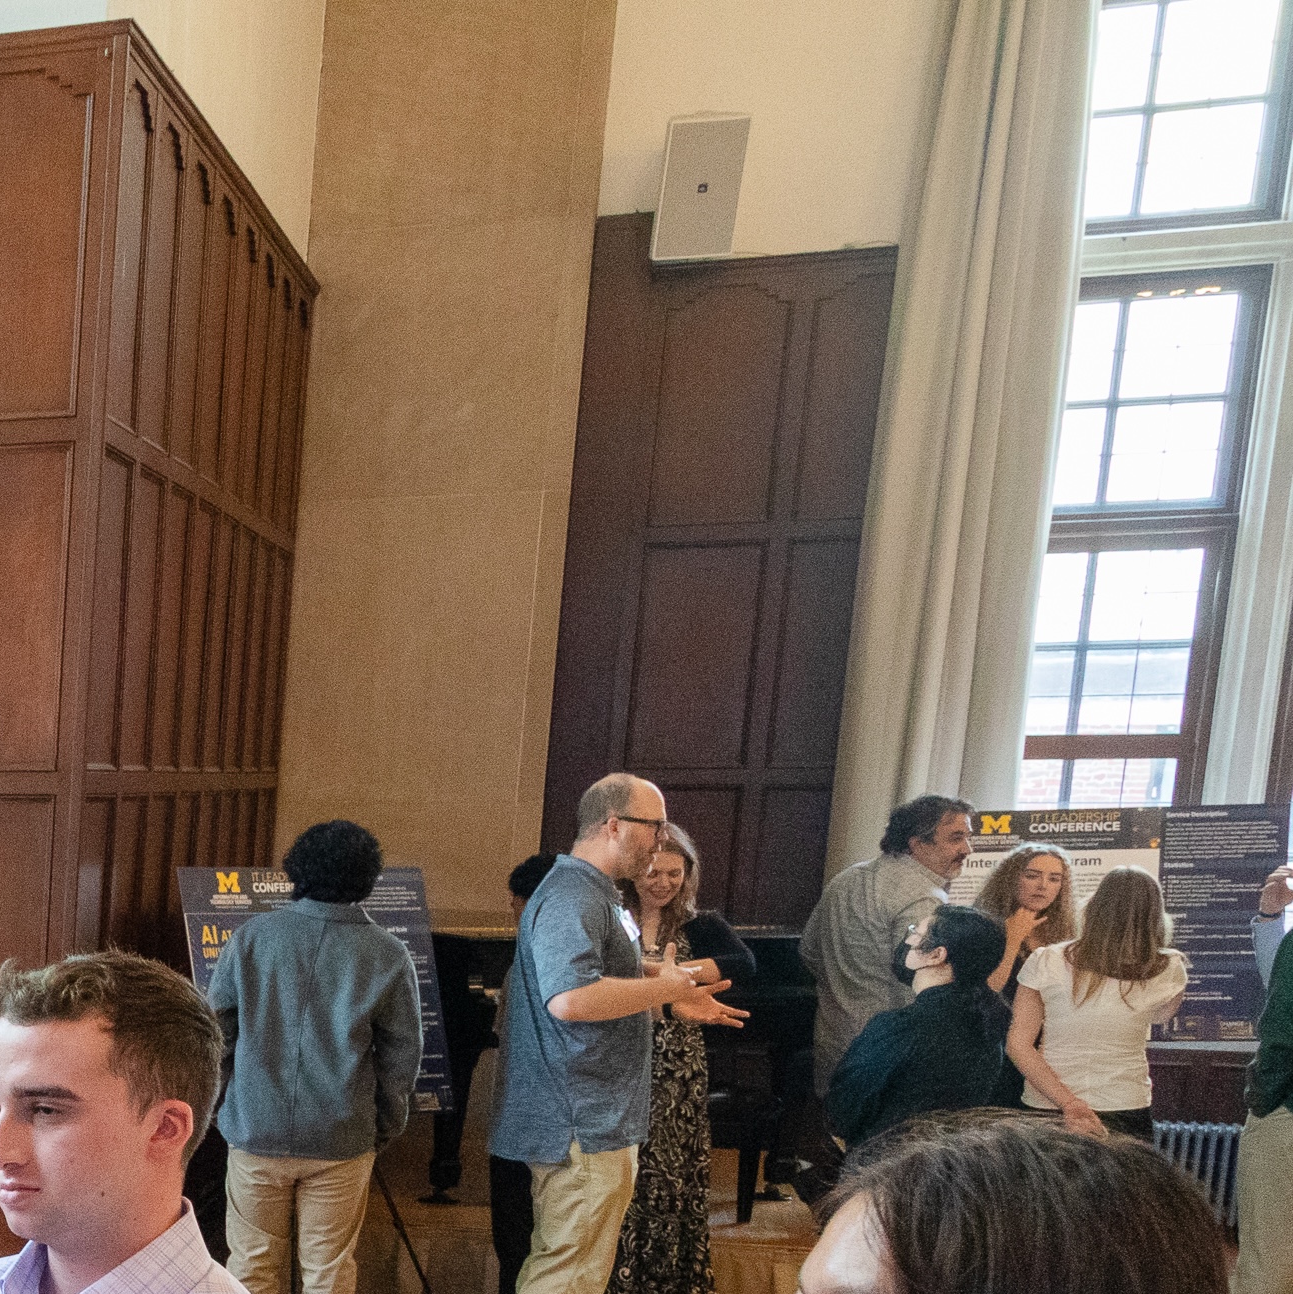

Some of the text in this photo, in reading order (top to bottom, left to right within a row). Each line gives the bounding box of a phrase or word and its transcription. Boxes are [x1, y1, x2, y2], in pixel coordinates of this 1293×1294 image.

[980, 814, 1012, 835] M
[1030, 811, 1121, 823] IT LEADERSHIP
[1029, 821, 1121, 834] CONFERENCE
[216, 872, 241, 893] M
[202, 925, 218, 945] AI
